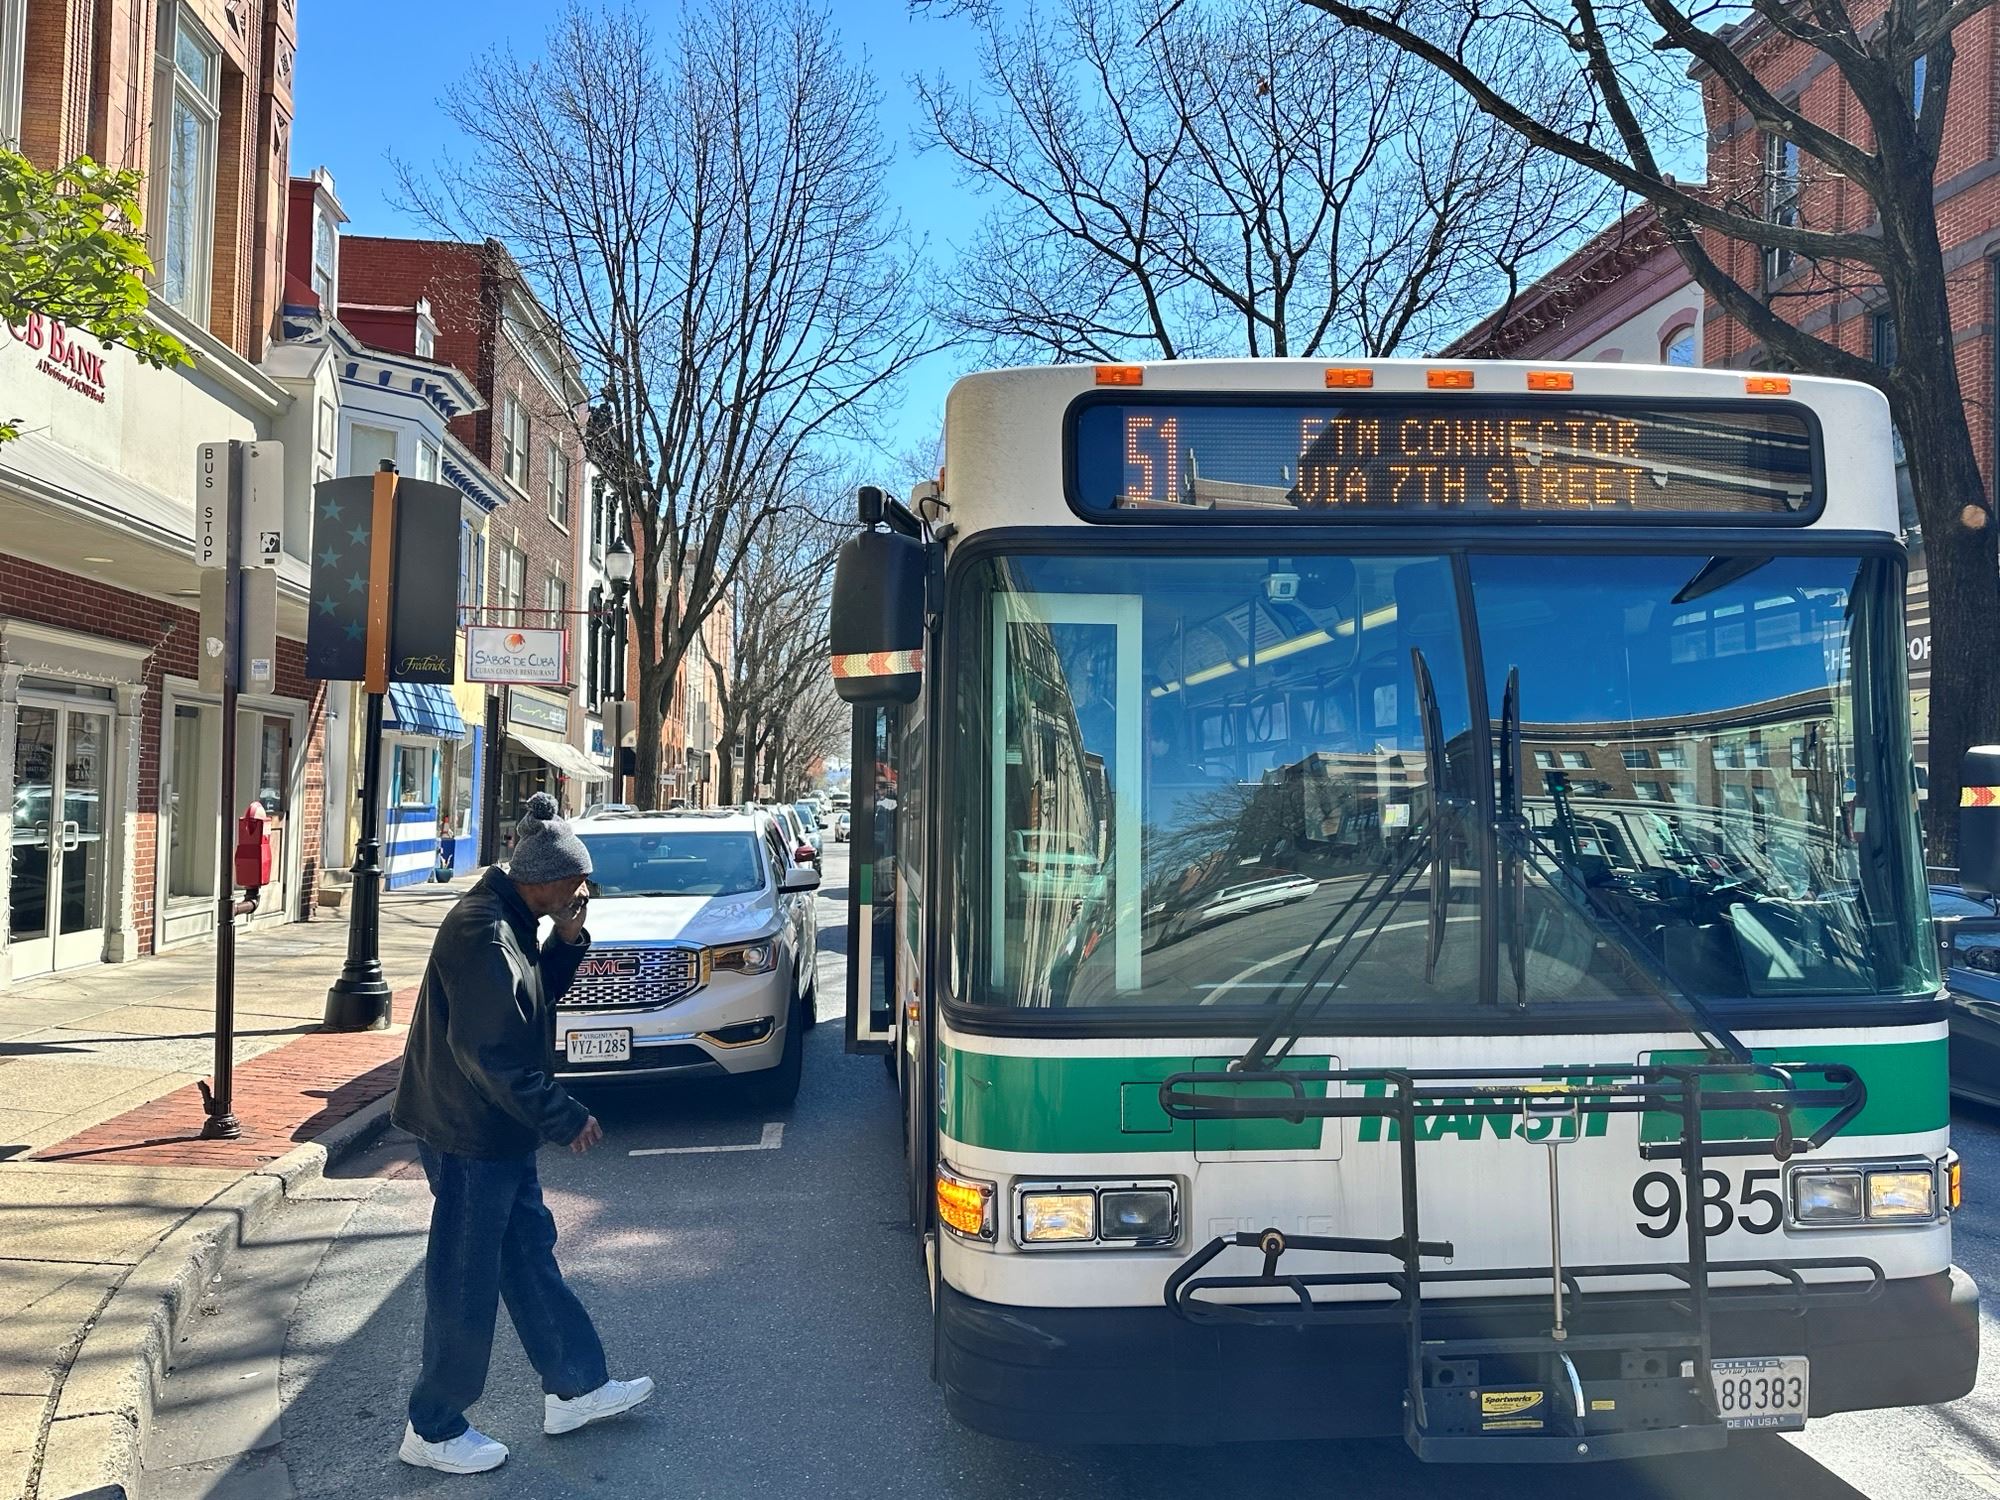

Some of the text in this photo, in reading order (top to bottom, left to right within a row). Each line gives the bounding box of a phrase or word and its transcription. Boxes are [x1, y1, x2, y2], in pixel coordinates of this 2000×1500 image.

[7, 312, 106, 389] CB BANK
[1401, 420, 1639, 458] CONNECTOR
[1128, 417, 1177, 502] 51
[1299, 466, 1643, 504] VIA 7TH STREET
[203, 448, 213, 562] BUS STOP
[394, 654, 451, 676] Frederick
[475, 667, 494, 676] CUBAN
[519, 669, 555, 677] RESTAURANT
[571, 1039, 627, 1056] VYZ-1285
[583, 1032, 613, 1040] VIRGINIA
[1632, 1168, 1783, 1239] 985
[1484, 1395, 1532, 1405] Sportworks
[1721, 1376, 1802, 1411] 88383
[1726, 1420, 1741, 1429] DE
[1744, 1419, 1755, 1428] IN
